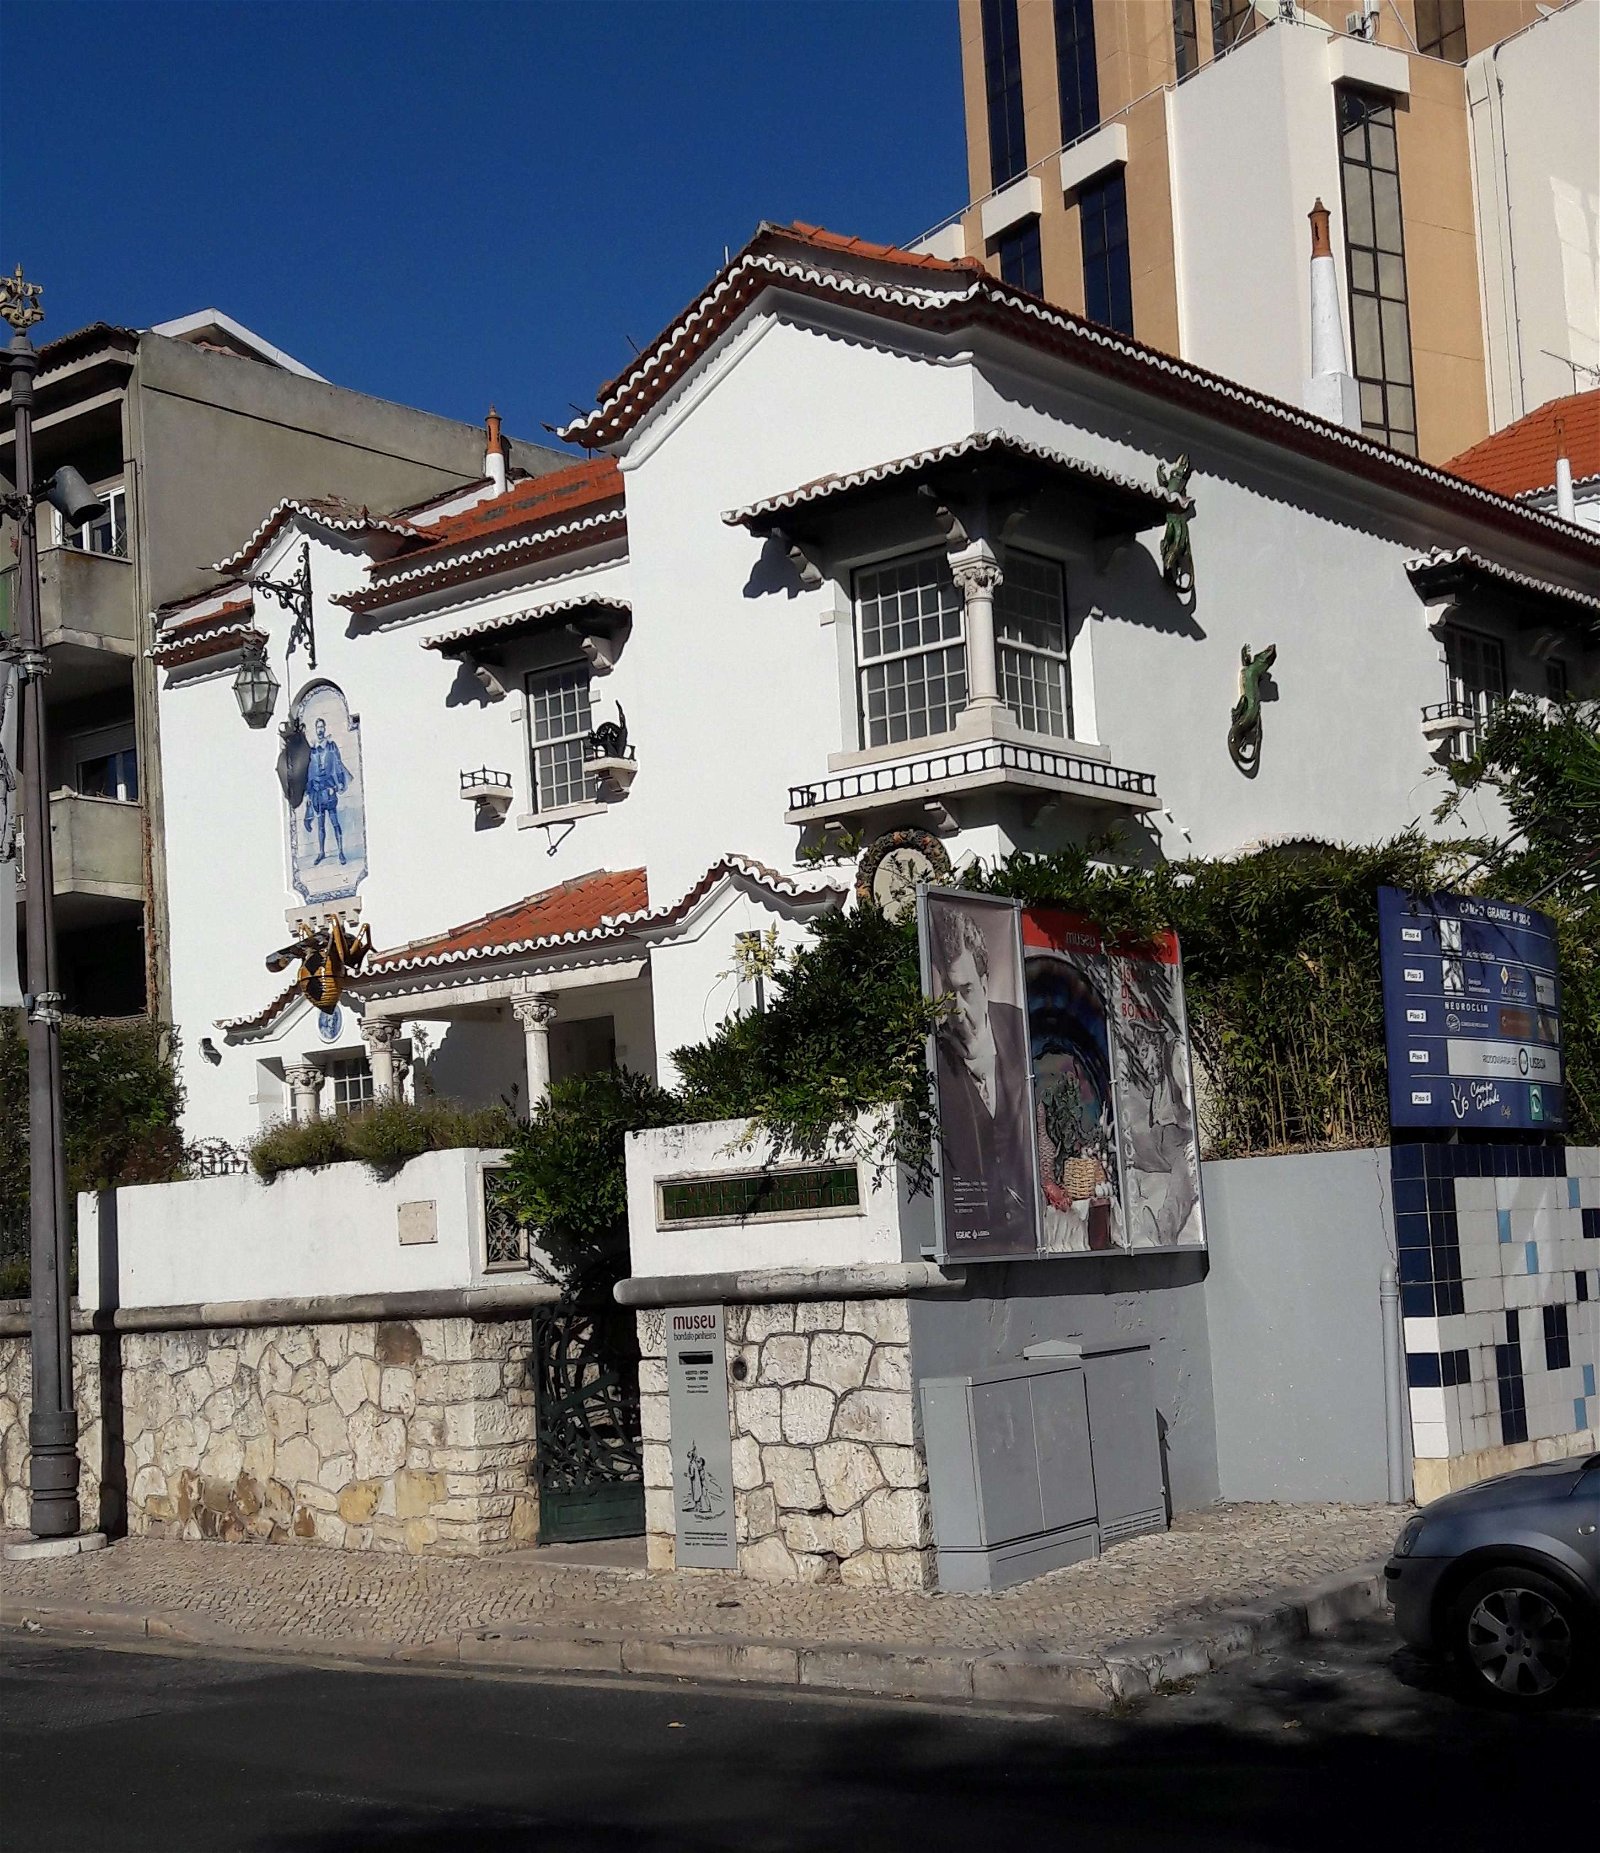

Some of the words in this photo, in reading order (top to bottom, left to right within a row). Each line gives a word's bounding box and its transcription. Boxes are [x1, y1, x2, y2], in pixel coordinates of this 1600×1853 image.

[1486, 906, 1511, 921] GRANDE
[1065, 931, 1096, 948] museu
[1407, 971, 1418, 979] Piso
[1470, 1081, 1494, 1098] Campo
[1476, 1088, 1500, 1112] Grande
[673, 1314, 716, 1330] museu
